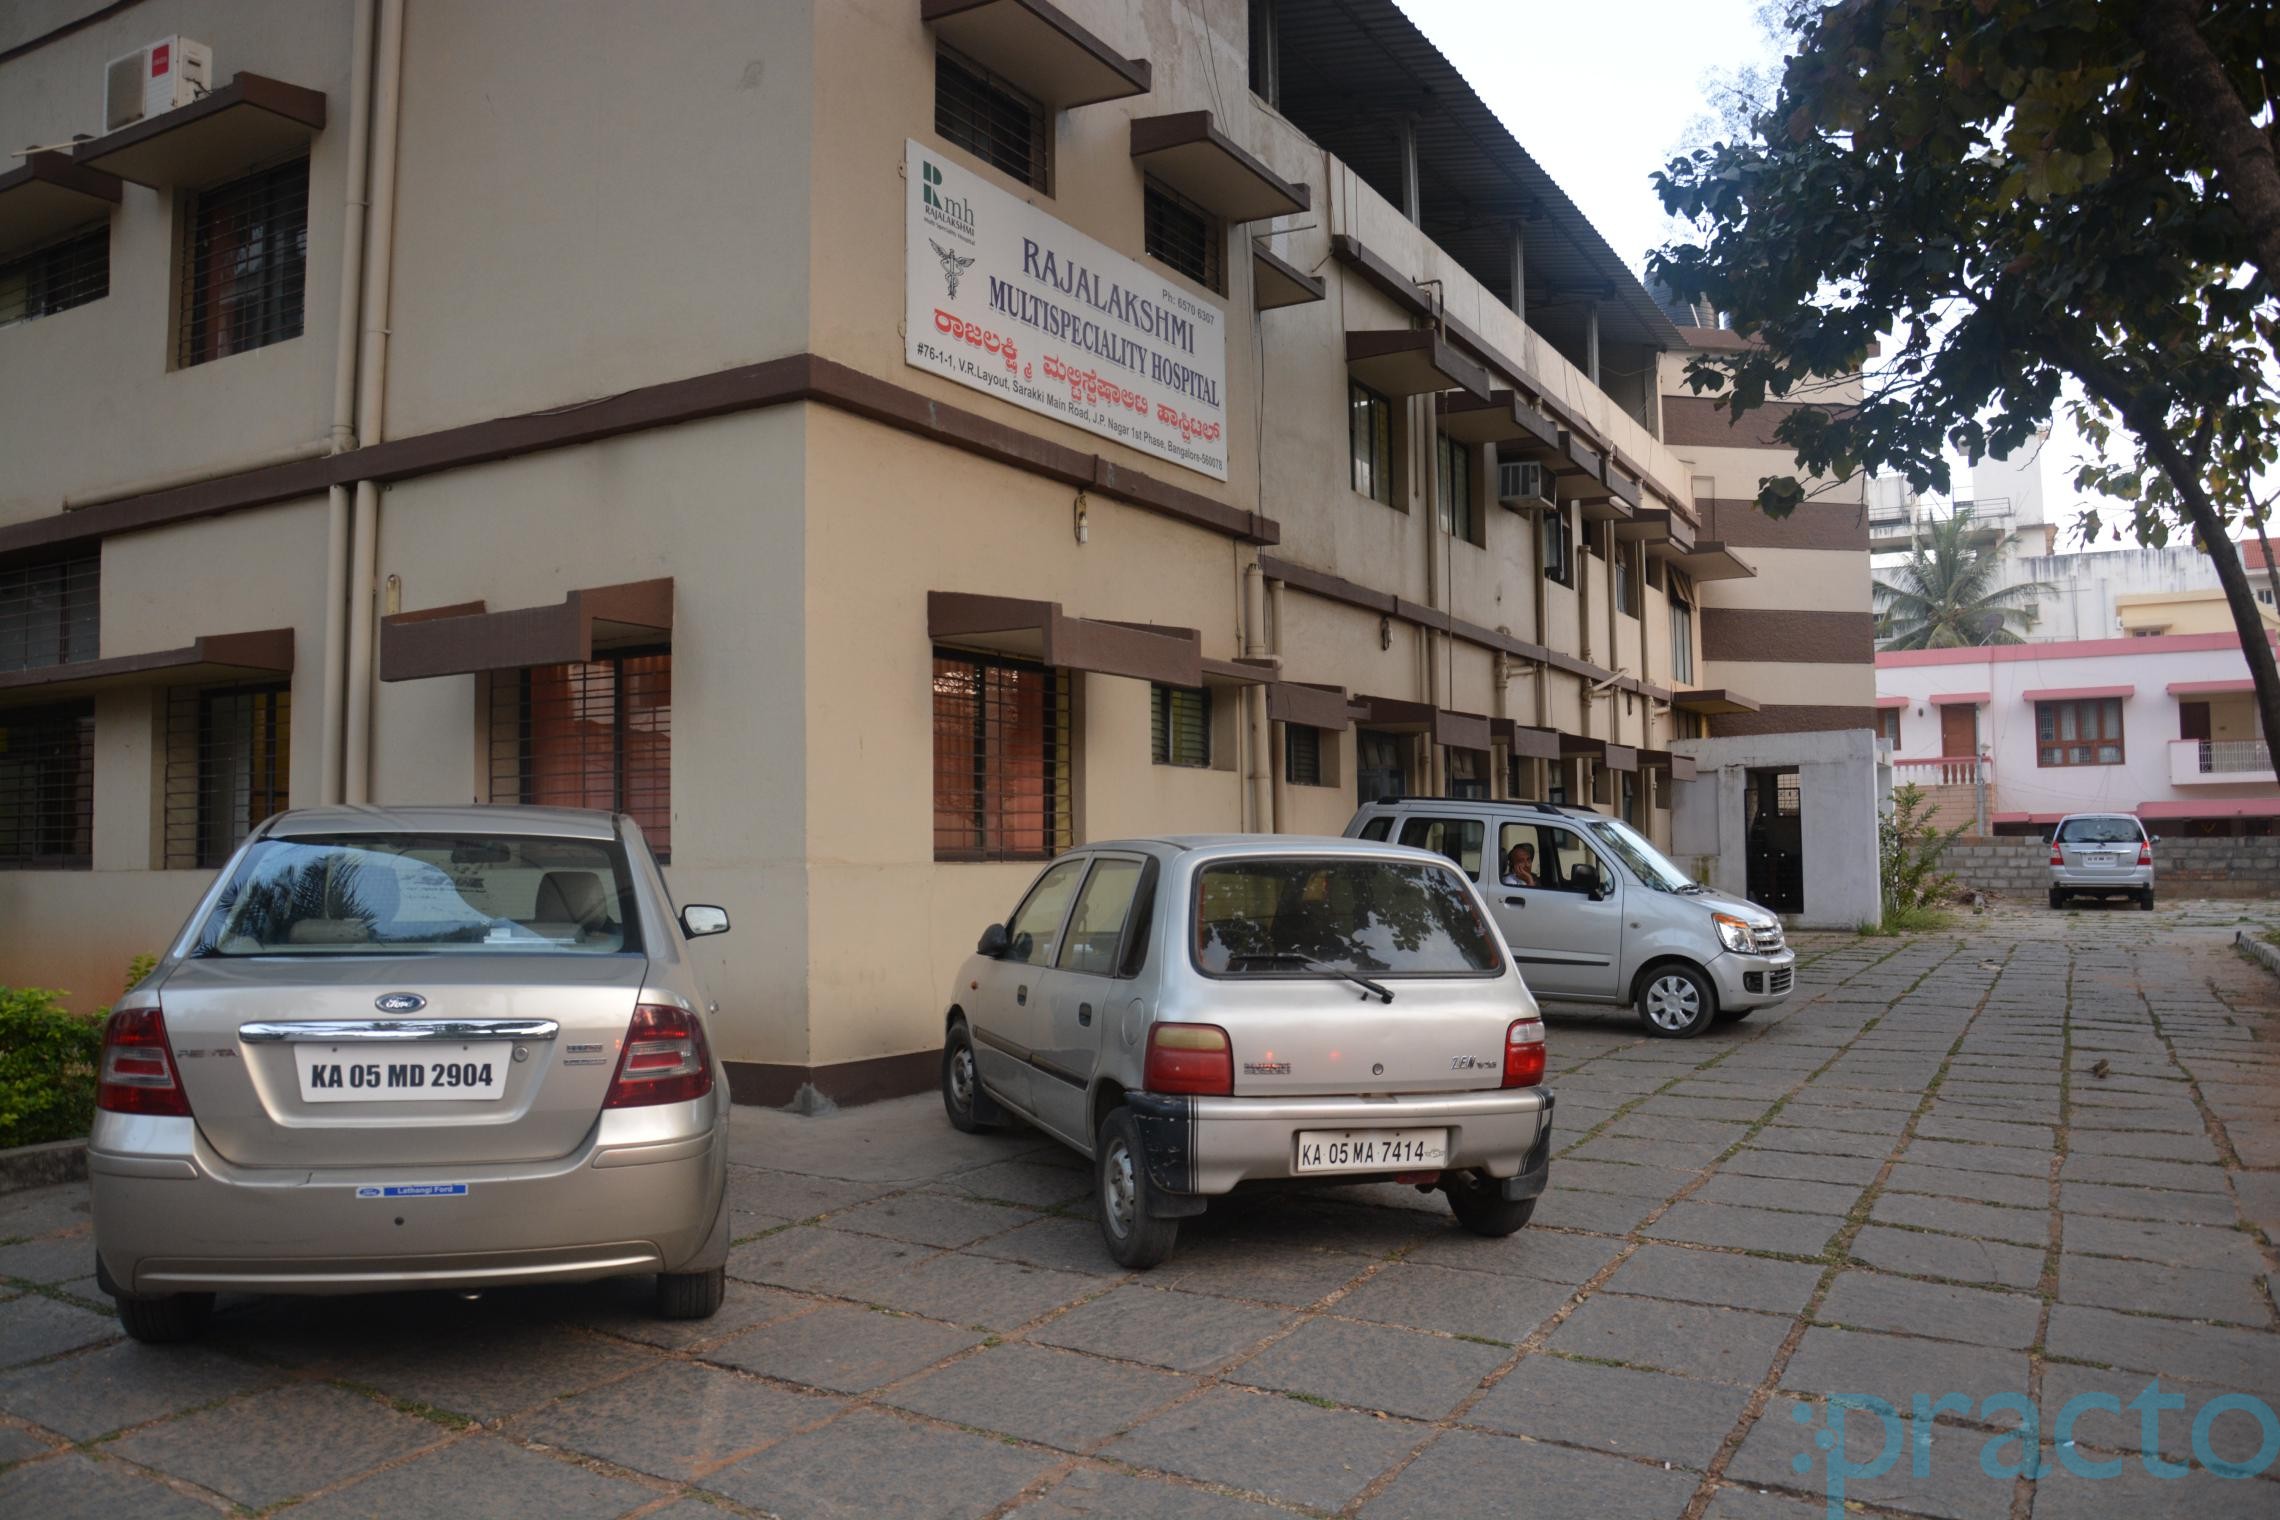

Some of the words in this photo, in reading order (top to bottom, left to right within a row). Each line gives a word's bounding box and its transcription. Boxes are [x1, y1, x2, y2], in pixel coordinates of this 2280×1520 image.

[925, 204, 975, 237] RAJALAKSHMI
[1023, 237, 1195, 355] RAJALAKSHMI
[1162, 289, 1176, 305] Ph:
[1177, 298, 1195, 316] 6570
[989, 275, 1148, 375] MULTISPECIALITY
[1151, 351, 1220, 408] HOSPITAL
[917, 342, 956, 372] #76-1-1,
[1012, 380, 1044, 402] Sarakki
[1046, 393, 1066, 412] Main
[1068, 402, 1091, 423] Road,
[1092, 414, 1106, 428] J.P.
[1108, 418, 1129, 437] Nagar
[1131, 426, 1142, 441] 1st
[1143, 431, 1166, 450] Phase,
[385, 997, 415, 1009] Ford
[311, 1064, 343, 1088] KA
[350, 1064, 381, 1088] 05
[388, 1063, 425, 1087] MD
[431, 1063, 493, 1087] 2904
[1302, 1144, 1321, 1166] KA
[1329, 1143, 1349, 1164] 05
[1353, 1142, 1374, 1163] MA
[1382, 1141, 1424, 1162] 7414
